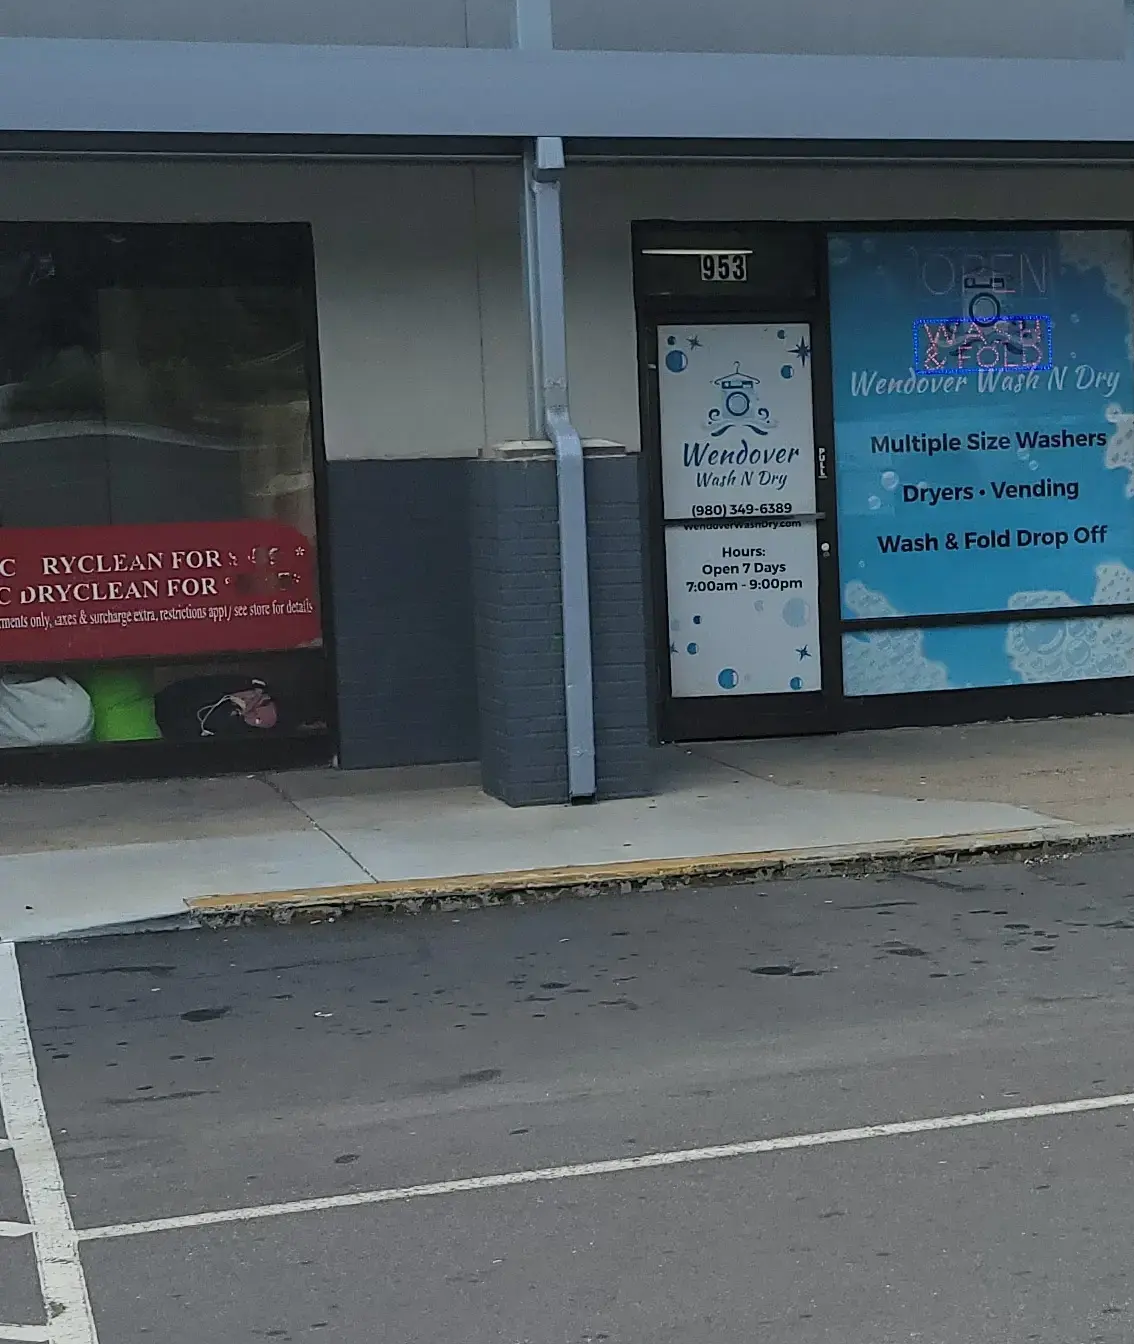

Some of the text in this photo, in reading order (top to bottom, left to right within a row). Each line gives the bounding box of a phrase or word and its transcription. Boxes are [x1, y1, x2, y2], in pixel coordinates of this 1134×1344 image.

[702, 254, 746, 280] 953
[921, 253, 1047, 295] OPEN
[923, 319, 1041, 346] WASH
[957, 343, 1043, 369] FOLD
[850, 364, 1121, 397] Wendover Wash N Dry
[683, 438, 800, 468] Wendover
[871, 429, 1108, 456] Multiple Size Washers
[696, 469, 788, 491] Wash N Dry
[903, 478, 1079, 506] Dryers Vending
[691, 502, 793, 518] (980) 349-6389
[722, 546, 766, 558] Hours:
[877, 524, 1109, 554] Wash & Fold Drop Off
[171, 549, 223, 569] FOR
[702, 562, 787, 577] Open 7 Days
[20, 579, 159, 605] DRYCLEAN
[167, 577, 218, 597] FOR
[686, 580, 738, 592] 7:00am
[749, 578, 803, 591] 9:00pm
[54, 613, 78, 626] axes
[79, 609, 88, 625] &
[89, 608, 132, 627] surcharge
[159, 603, 207, 621] restrictions
[234, 605, 248, 617] see
[249, 603, 270, 616] store
[272, 599, 285, 615] for
